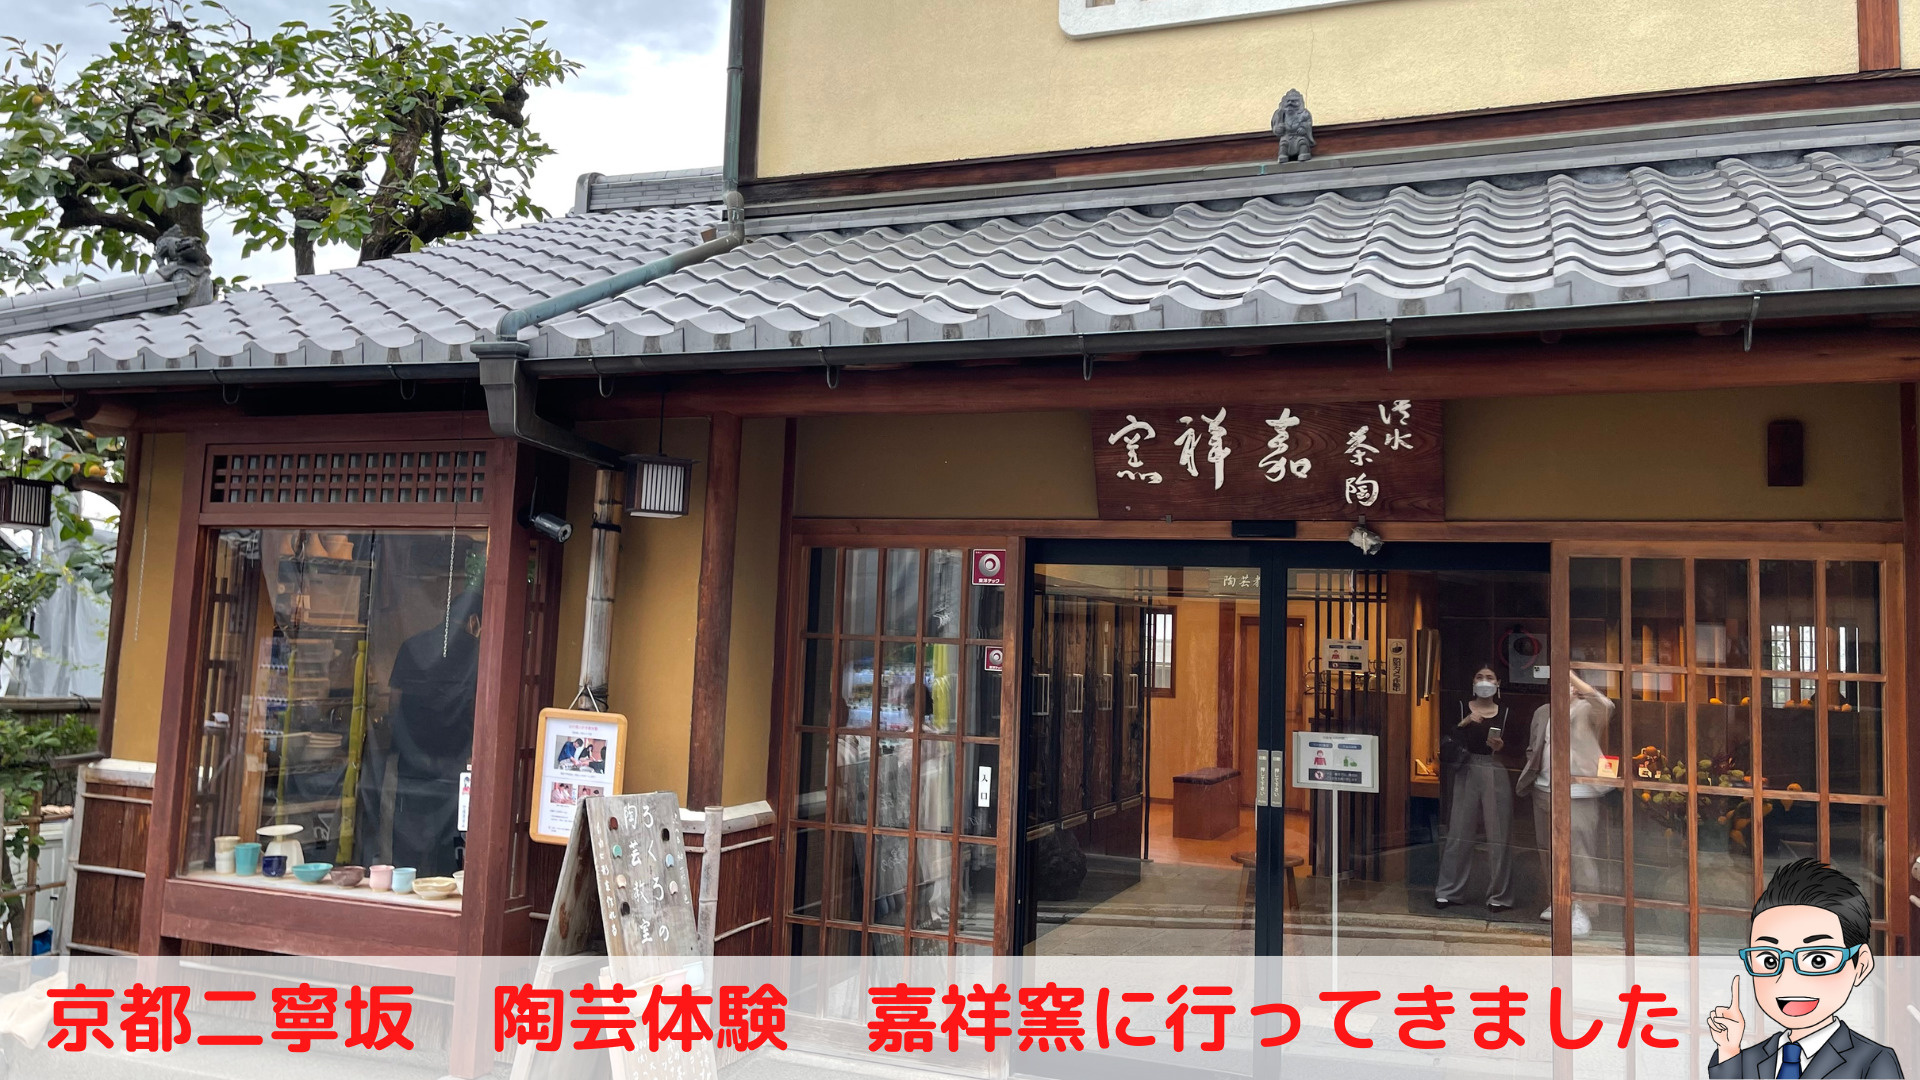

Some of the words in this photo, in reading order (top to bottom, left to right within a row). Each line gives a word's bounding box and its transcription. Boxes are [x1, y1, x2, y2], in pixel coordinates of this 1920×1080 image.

[1345, 425, 1379, 507] 茶陶
[980, 773, 989, 800] 入口
[623, 803, 653, 944] 陶芸教室
[642, 805, 670, 942] ろくろの
